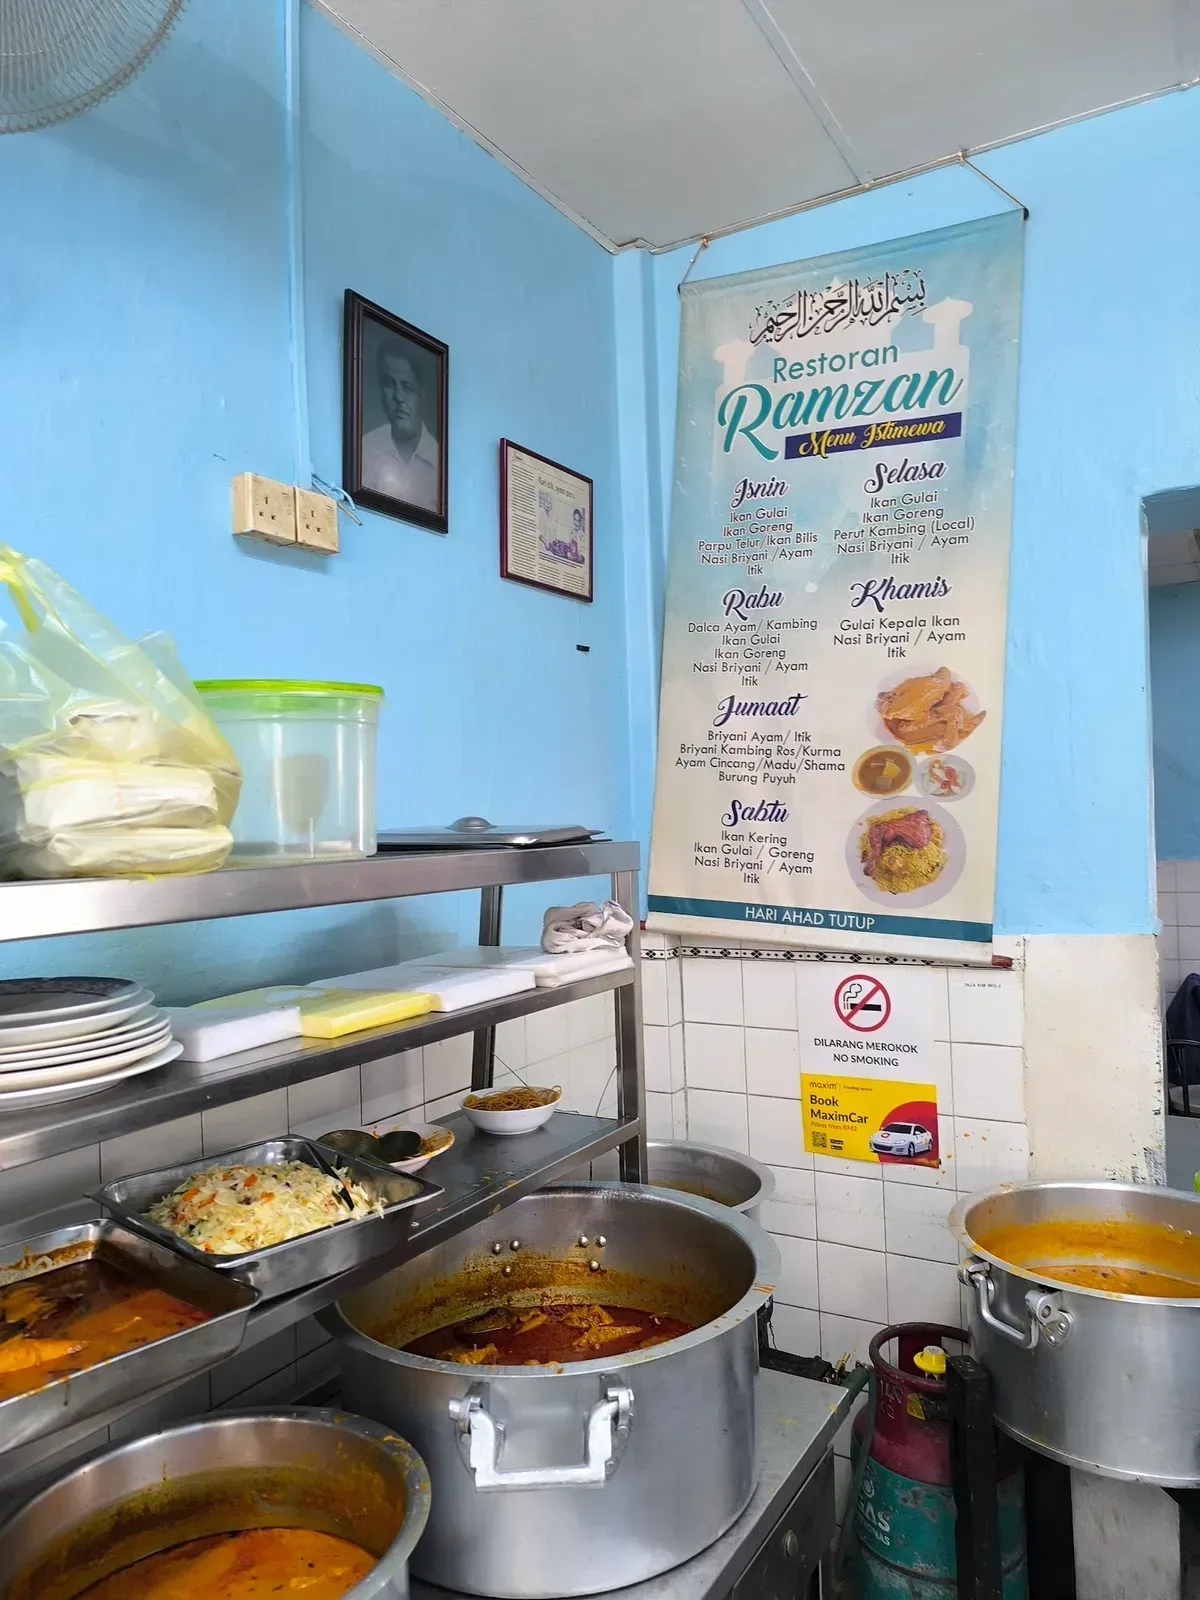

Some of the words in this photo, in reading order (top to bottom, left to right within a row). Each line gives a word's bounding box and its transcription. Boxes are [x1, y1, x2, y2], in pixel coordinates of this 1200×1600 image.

[773, 345, 899, 383] Restoran
[718, 367, 964, 461] Ramzan
[798, 430, 856, 459] Menu
[861, 418, 946, 450] Istimewa
[864, 458, 947, 493] Selasa
[731, 477, 788, 508] Isnin
[870, 497, 897, 509] Ikan
[901, 491, 938, 505] Gulai
[730, 512, 752, 523] Ikan
[755, 507, 788, 519] Gulai
[863, 512, 889, 523] Ikan
[893, 508, 944, 520] Goreng
[723, 526, 746, 537] Ikan
[749, 522, 793, 534] Goreng
[834, 528, 866, 540] Perut
[869, 523, 926, 537] Kambing
[931, 516, 975, 534] (Local)
[698, 541, 732, 553] Parpu
[795, 532, 818, 544] Bilis
[837, 542, 865, 554] Nasi
[869, 538, 913, 552] Briyani
[930, 535, 969, 548] Ayam
[701, 554, 727, 565] Nasi
[732, 550, 768, 564] Briyani
[891, 552, 910, 564] Itik
[747, 564, 764, 576] Itik
[850, 576, 952, 613] Khamis
[722, 585, 785, 621] Rabu
[688, 622, 720, 633] Dalca
[766, 618, 818, 631] Kambing
[840, 618, 875, 631] Gulai
[879, 616, 927, 631] Kepala
[931, 615, 960, 627] Ikan
[722, 635, 746, 646] Ikan
[750, 633, 780, 645] Gulai
[833, 634, 861, 646] Nasi
[866, 632, 910, 646] Briyani
[926, 630, 966, 644] Ayam
[714, 648, 739, 659] Ikan
[743, 648, 786, 660] Goreng
[887, 646, 906, 658] Itik
[693, 662, 717, 673] Nasi
[721, 662, 761, 675] Briyani
[775, 661, 808, 674] Ayam
[741, 676, 758, 687] Itik
[712, 693, 809, 727] Jumaat
[707, 730, 747, 743] Briyani
[794, 731, 812, 742] Itik
[680, 743, 717, 756] Briyani
[720, 743, 772, 758] Kambing
[675, 757, 706, 770] Ayam
[718, 771, 758, 785] Burung
[762, 773, 796, 786] Puyuh
[721, 799, 790, 827] Sabtu
[721, 830, 745, 842] Ikan
[748, 831, 787, 847] Kering
[693, 842, 717, 854] Ikan
[721, 844, 753, 856] Gulai
[768, 847, 815, 862] Goreng
[694, 856, 720, 867] Nasi
[724, 857, 763, 872] Briyani
[778, 862, 813, 876] Ayam
[743, 873, 760, 884] Itik
[745, 906, 777, 921] HARI
[782, 909, 824, 925] AHAD
[829, 913, 875, 930] TUTUP
[814, 1037, 864, 1050] DILARANG
[866, 1041, 918, 1054] MEROKOK
[833, 1053, 849, 1063] NO
[851, 1055, 899, 1067] SMOKING
[810, 1094, 839, 1107] Book
[810, 1108, 869, 1124] MaximCar
[811, 1121, 827, 1129] Prices
[828, 1122, 843, 1130] from
[843, 1123, 857, 1131] RM2
